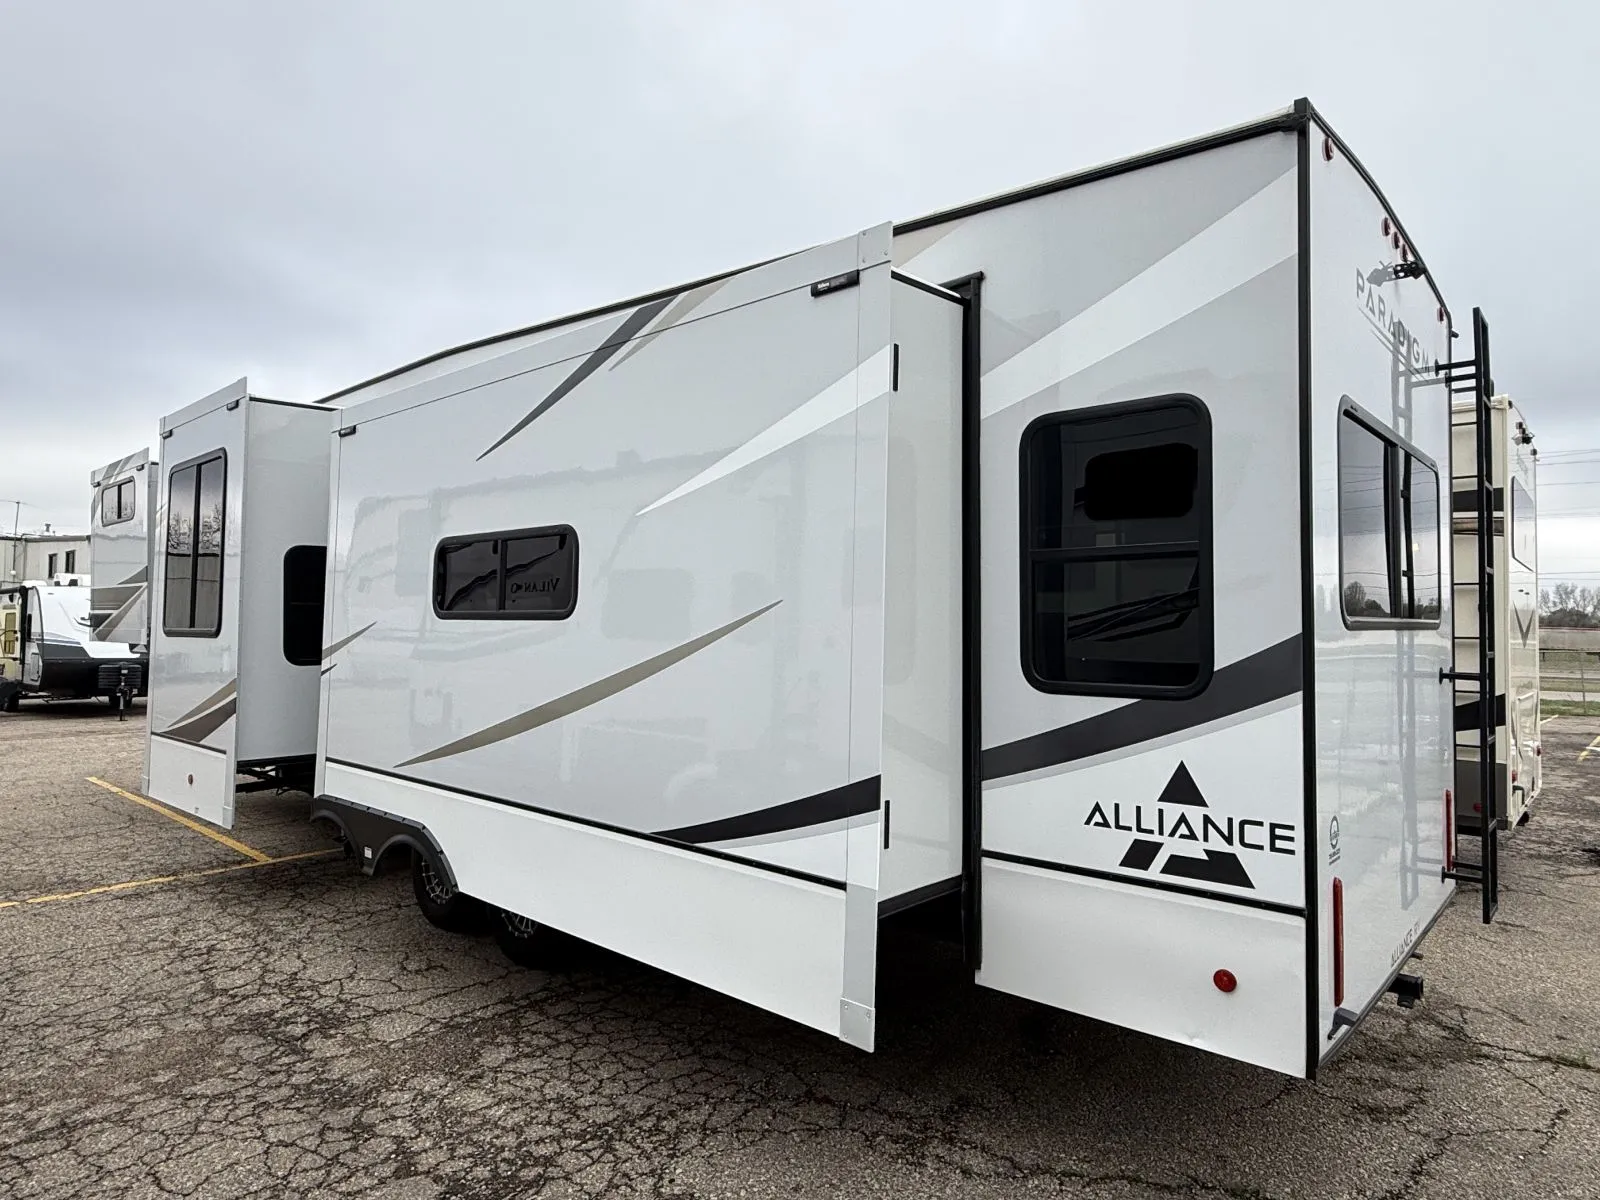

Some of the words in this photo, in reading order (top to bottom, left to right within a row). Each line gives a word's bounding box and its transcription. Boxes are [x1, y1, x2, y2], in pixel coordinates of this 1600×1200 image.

[1356, 268, 1430, 376] PARADIGM
[1083, 801, 1296, 856] ALLIANCE
[1391, 927, 1413, 967] ALLIANCE
